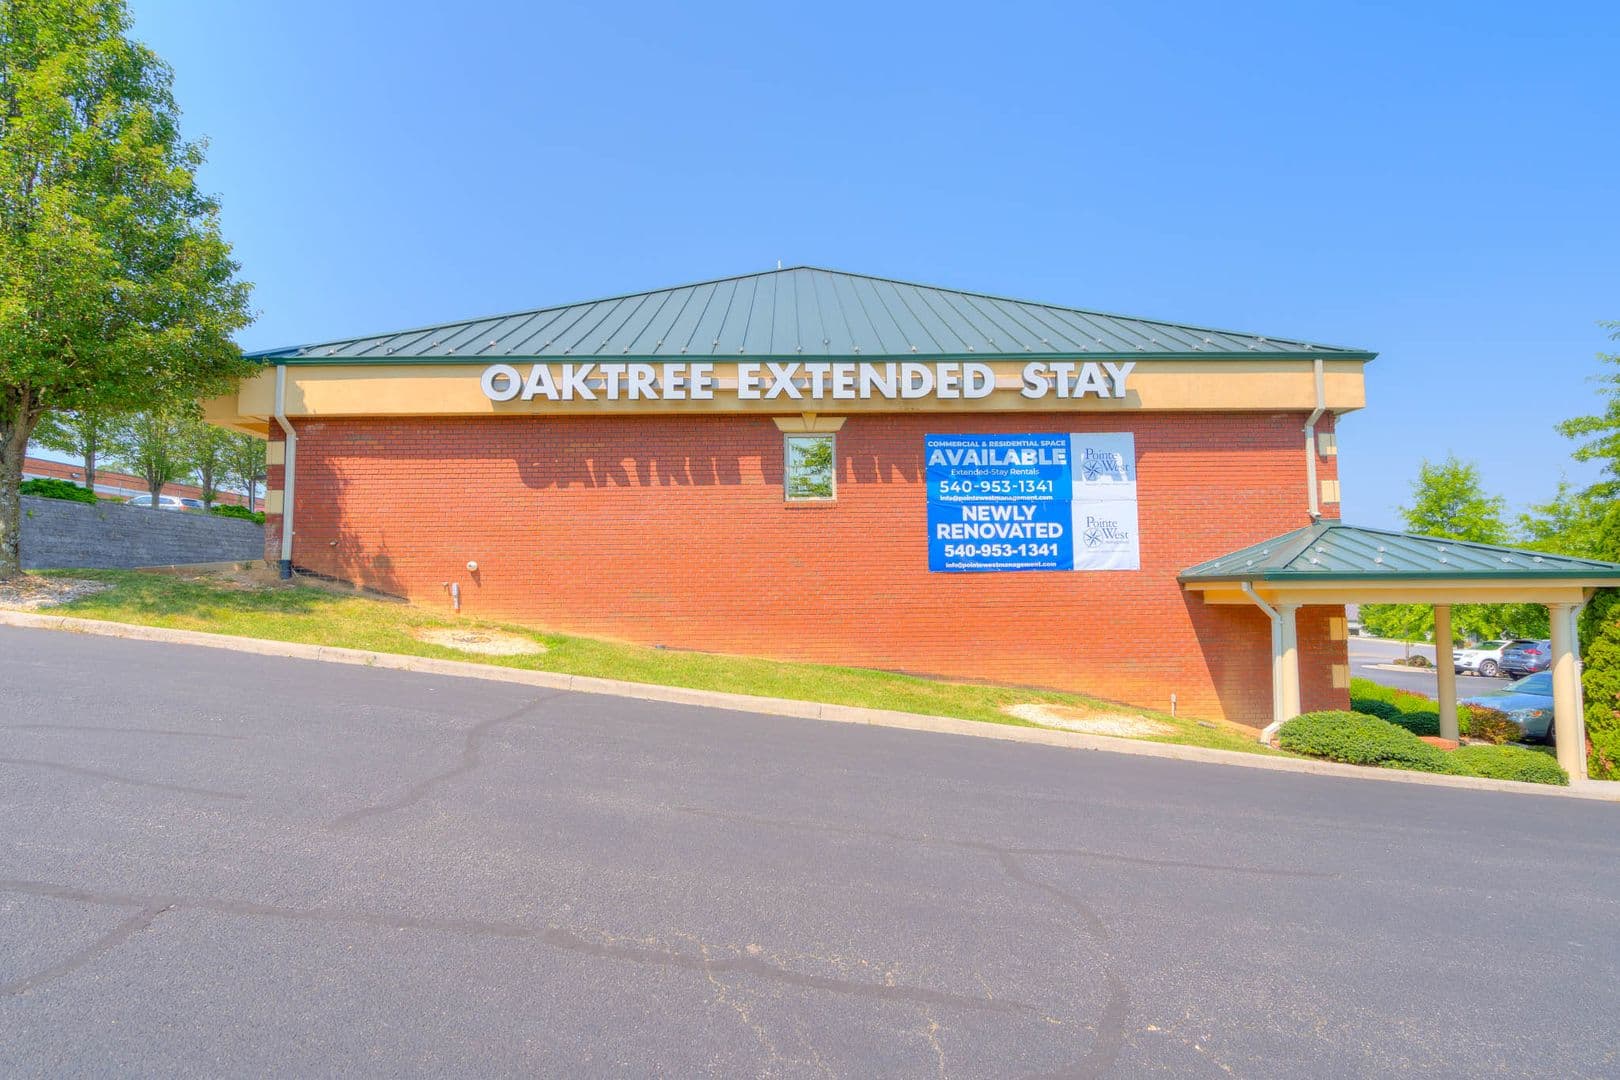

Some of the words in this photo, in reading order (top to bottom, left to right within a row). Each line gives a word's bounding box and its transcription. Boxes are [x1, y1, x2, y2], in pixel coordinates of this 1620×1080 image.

[480, 362, 714, 402] OAKTREE
[737, 361, 996, 401] EXTENDED
[1020, 361, 1136, 400] STAY
[928, 449, 1067, 466] AVAILABLE
[1086, 448, 1118, 460] Pointe
[1101, 459, 1129, 472] West
[940, 480, 1053, 493] 540-953-1341
[962, 505, 1037, 521] NEWLY
[1086, 516, 1119, 528] Pointe
[937, 523, 1063, 539] RENOVATED
[1101, 527, 1129, 540] West
[944, 544, 1058, 557] 540-953-1341
